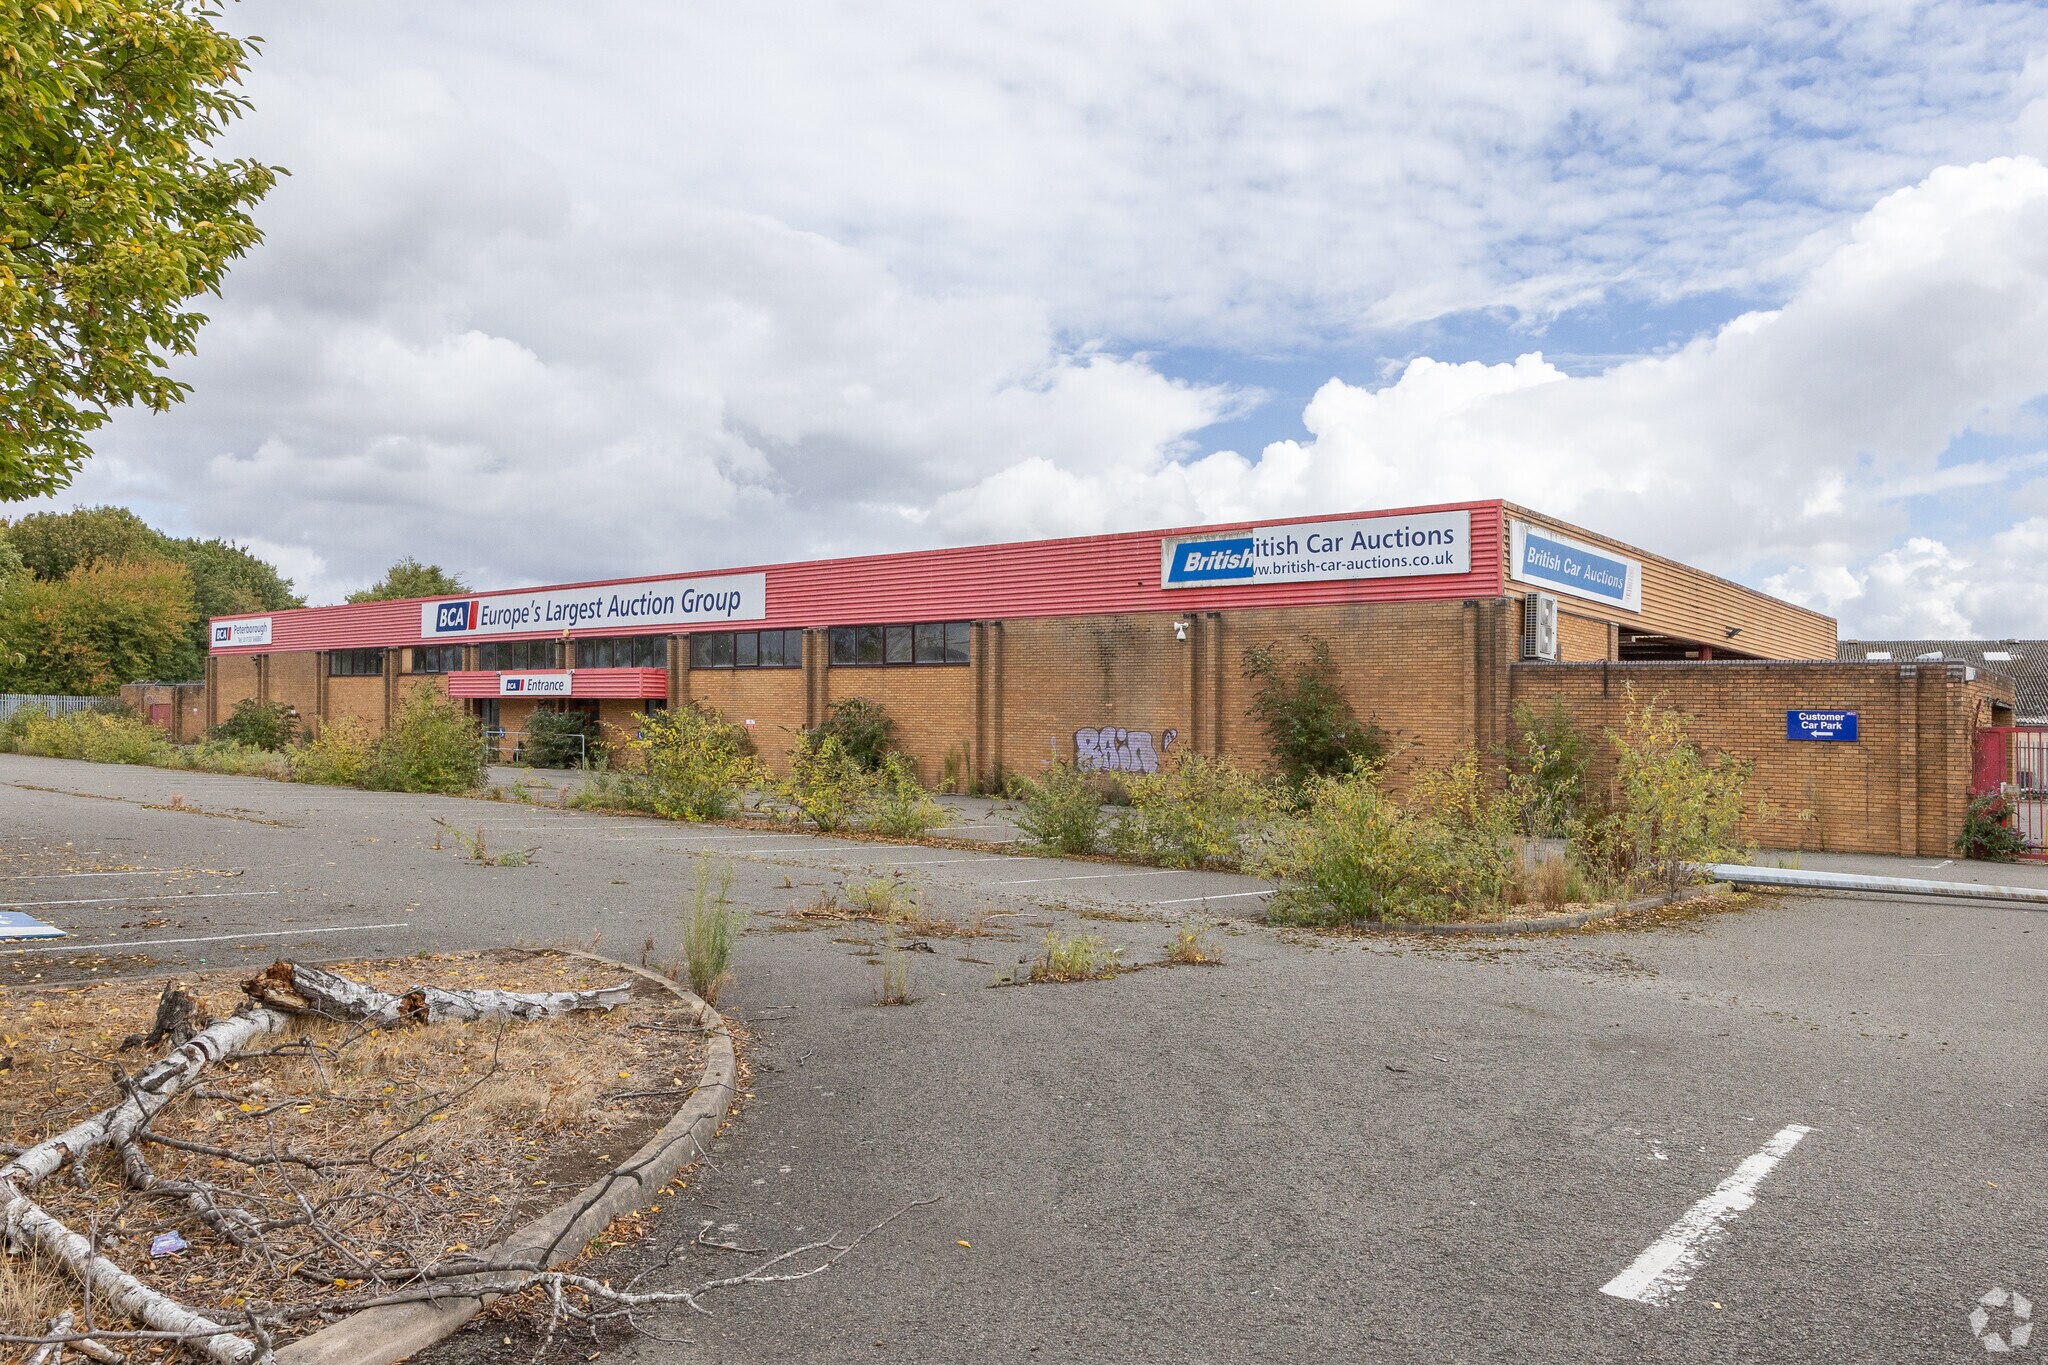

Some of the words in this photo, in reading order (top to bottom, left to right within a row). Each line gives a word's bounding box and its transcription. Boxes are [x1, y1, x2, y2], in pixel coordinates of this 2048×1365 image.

[1252, 535, 1298, 558] itish
[1306, 533, 1343, 553] Car
[1350, 526, 1454, 550] Auctions
[1183, 548, 1253, 572] British
[1527, 546, 1560, 572] British
[1563, 558, 1581, 577] Car
[1583, 564, 1623, 589] Auctions
[439, 607, 464, 627] BCA
[481, 600, 541, 629] Europe's
[545, 597, 603, 626] Largest
[607, 591, 674, 618] Auction
[681, 588, 741, 617] Group
[234, 622, 267, 636] Peterborough
[527, 679, 564, 691] Entrance
[1798, 712, 1844, 720] Customer
[1801, 721, 1818, 729] Car
[1820, 721, 1842, 730] Park
